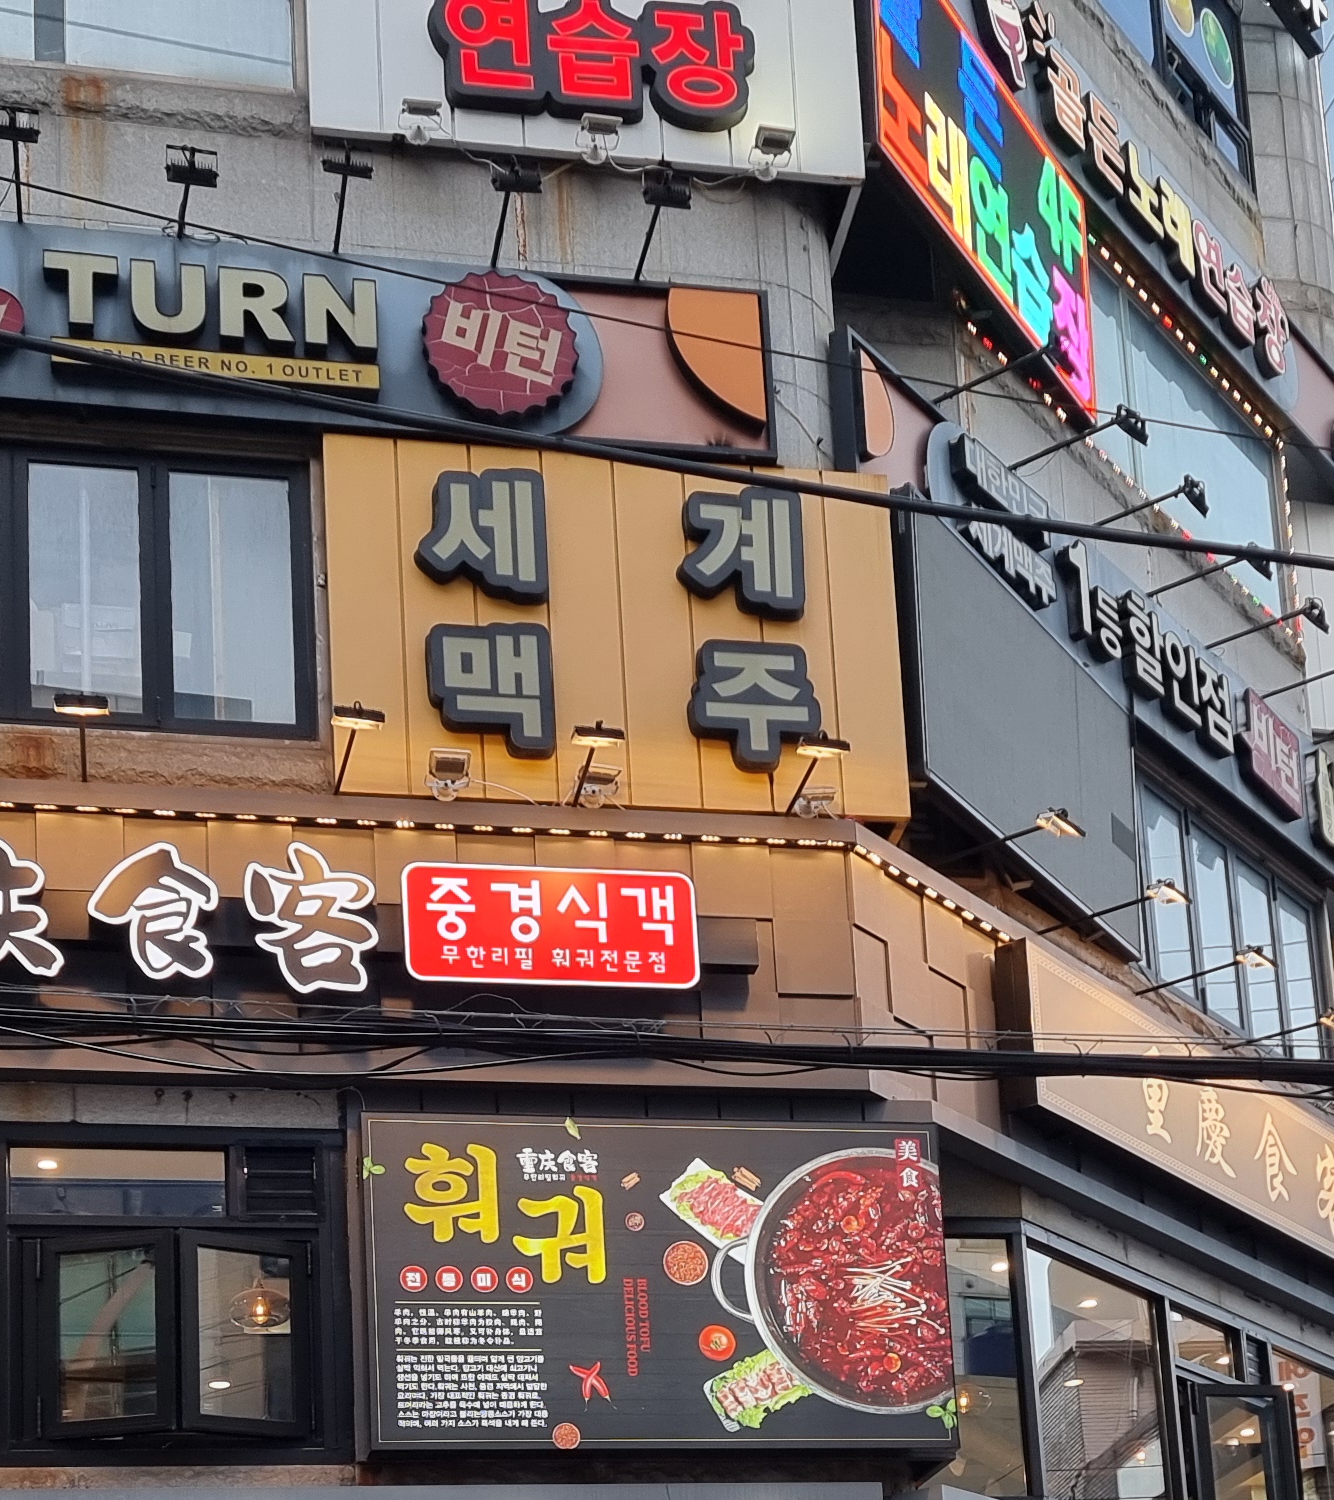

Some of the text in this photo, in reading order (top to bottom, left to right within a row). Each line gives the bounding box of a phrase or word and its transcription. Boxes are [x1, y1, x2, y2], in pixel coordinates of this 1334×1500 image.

[444, 0, 745, 109] 연습장
[1037, 156, 1085, 274] 4F
[282, 363, 364, 383] OUTLET
[441, 302, 563, 386] 비턴
[430, 474, 799, 601] 세계
[437, 633, 814, 753] 맥주
[1068, 539, 1235, 758] 1등할인점
[425, 877, 677, 947] 중경식객
[440, 944, 668, 974] 무한리필 훠궈전문점
[402, 1142, 608, 1285] 훠궈
[515, 1147, 599, 1174] 重庆食客
